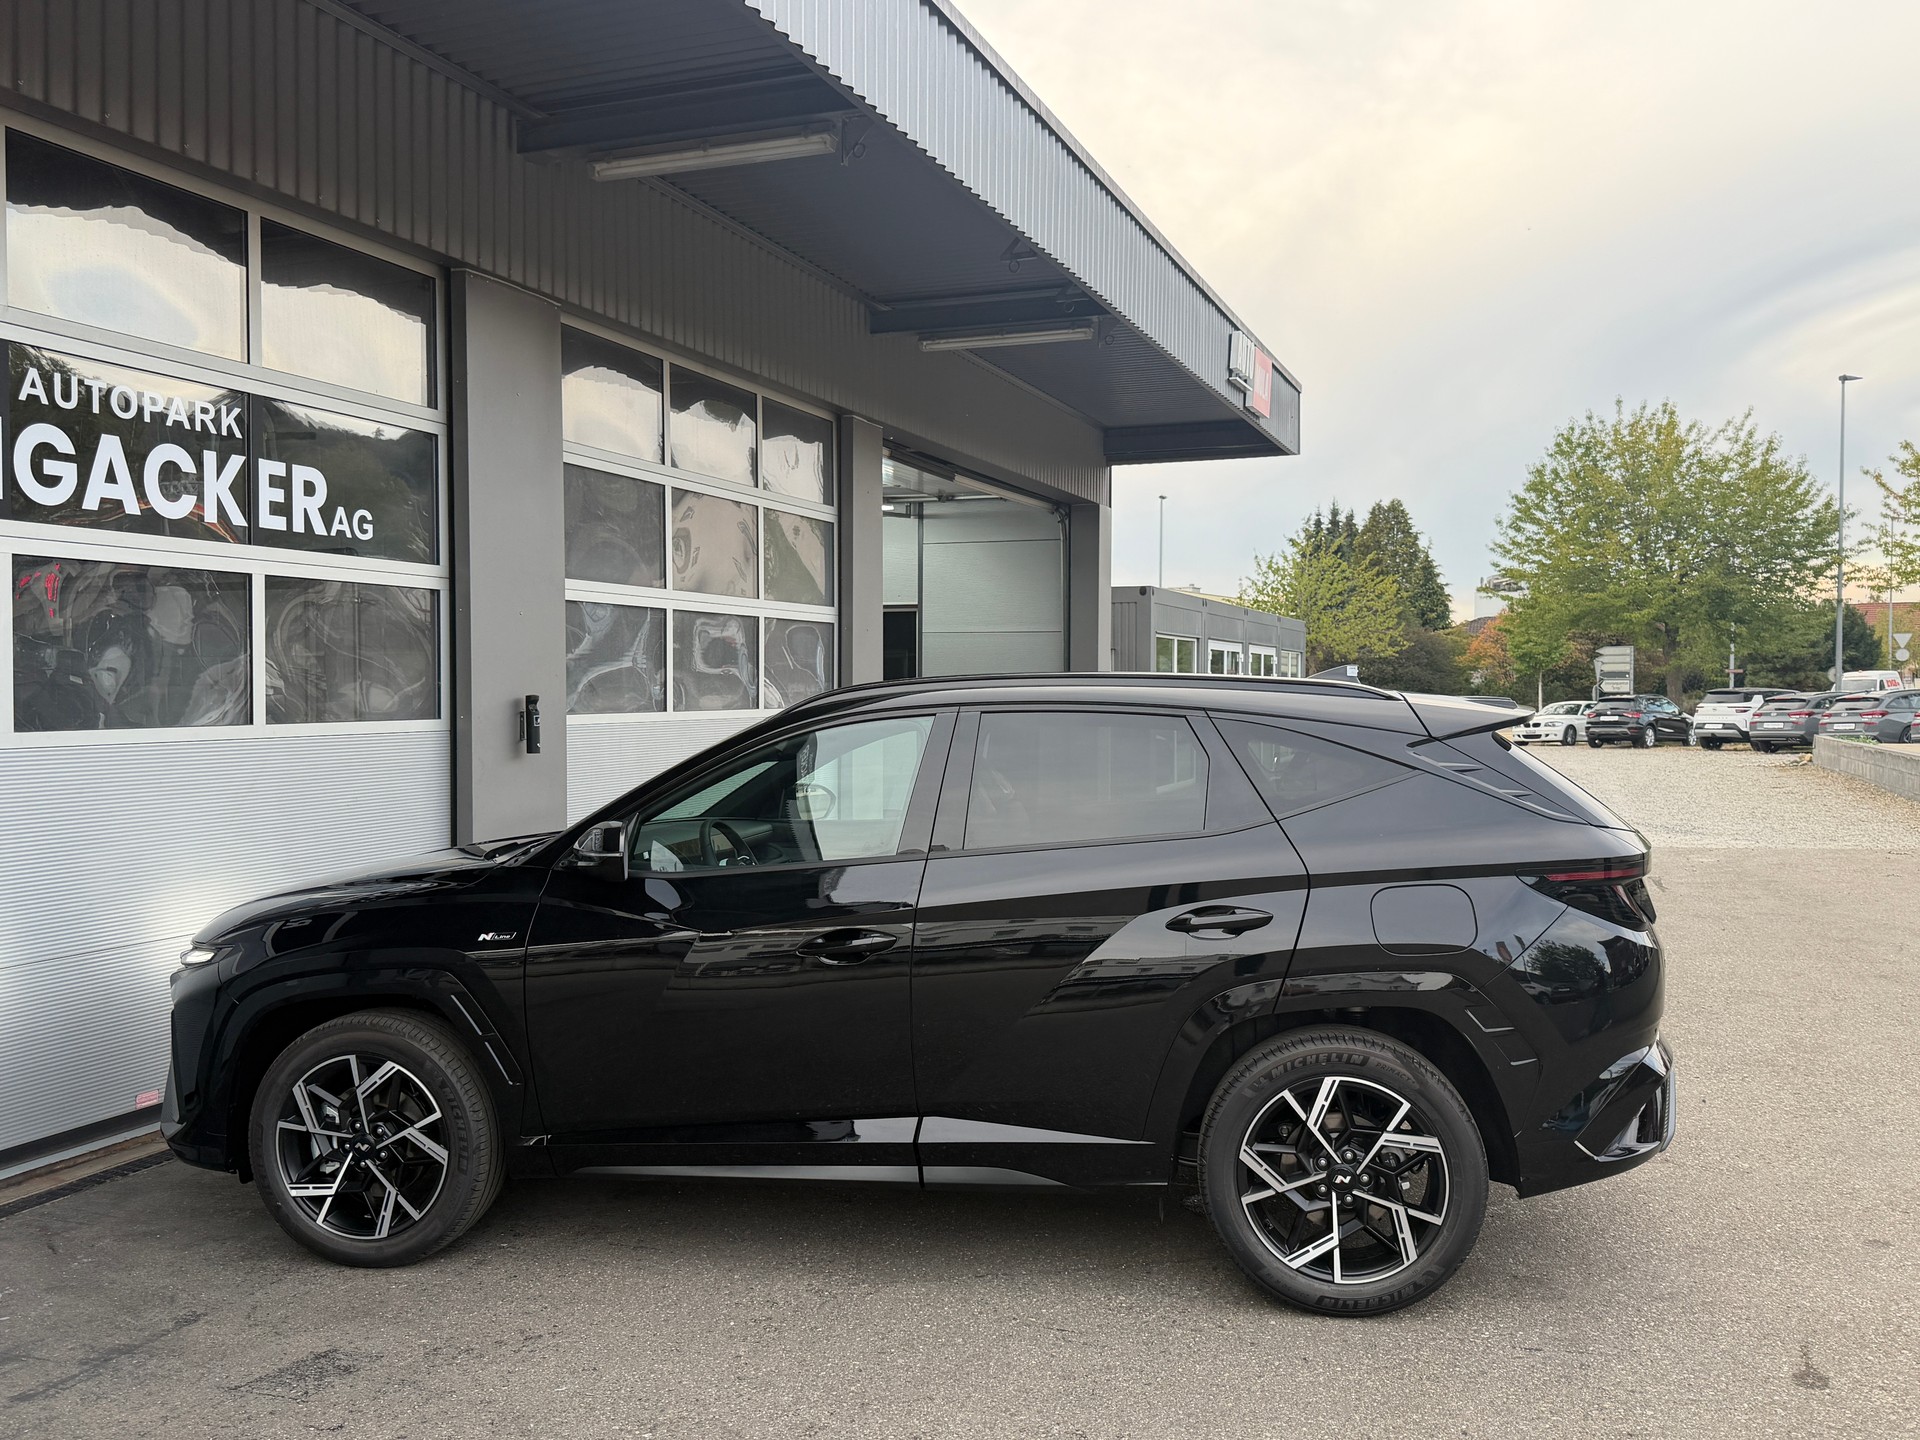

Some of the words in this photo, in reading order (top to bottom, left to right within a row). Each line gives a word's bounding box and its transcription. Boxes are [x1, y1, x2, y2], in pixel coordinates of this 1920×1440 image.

[18, 367, 243, 439] AUTOPARK
[0, 421, 328, 536] GACKER
[330, 507, 374, 540] AG
[1271, 1052, 1364, 1080] MICHELIN
